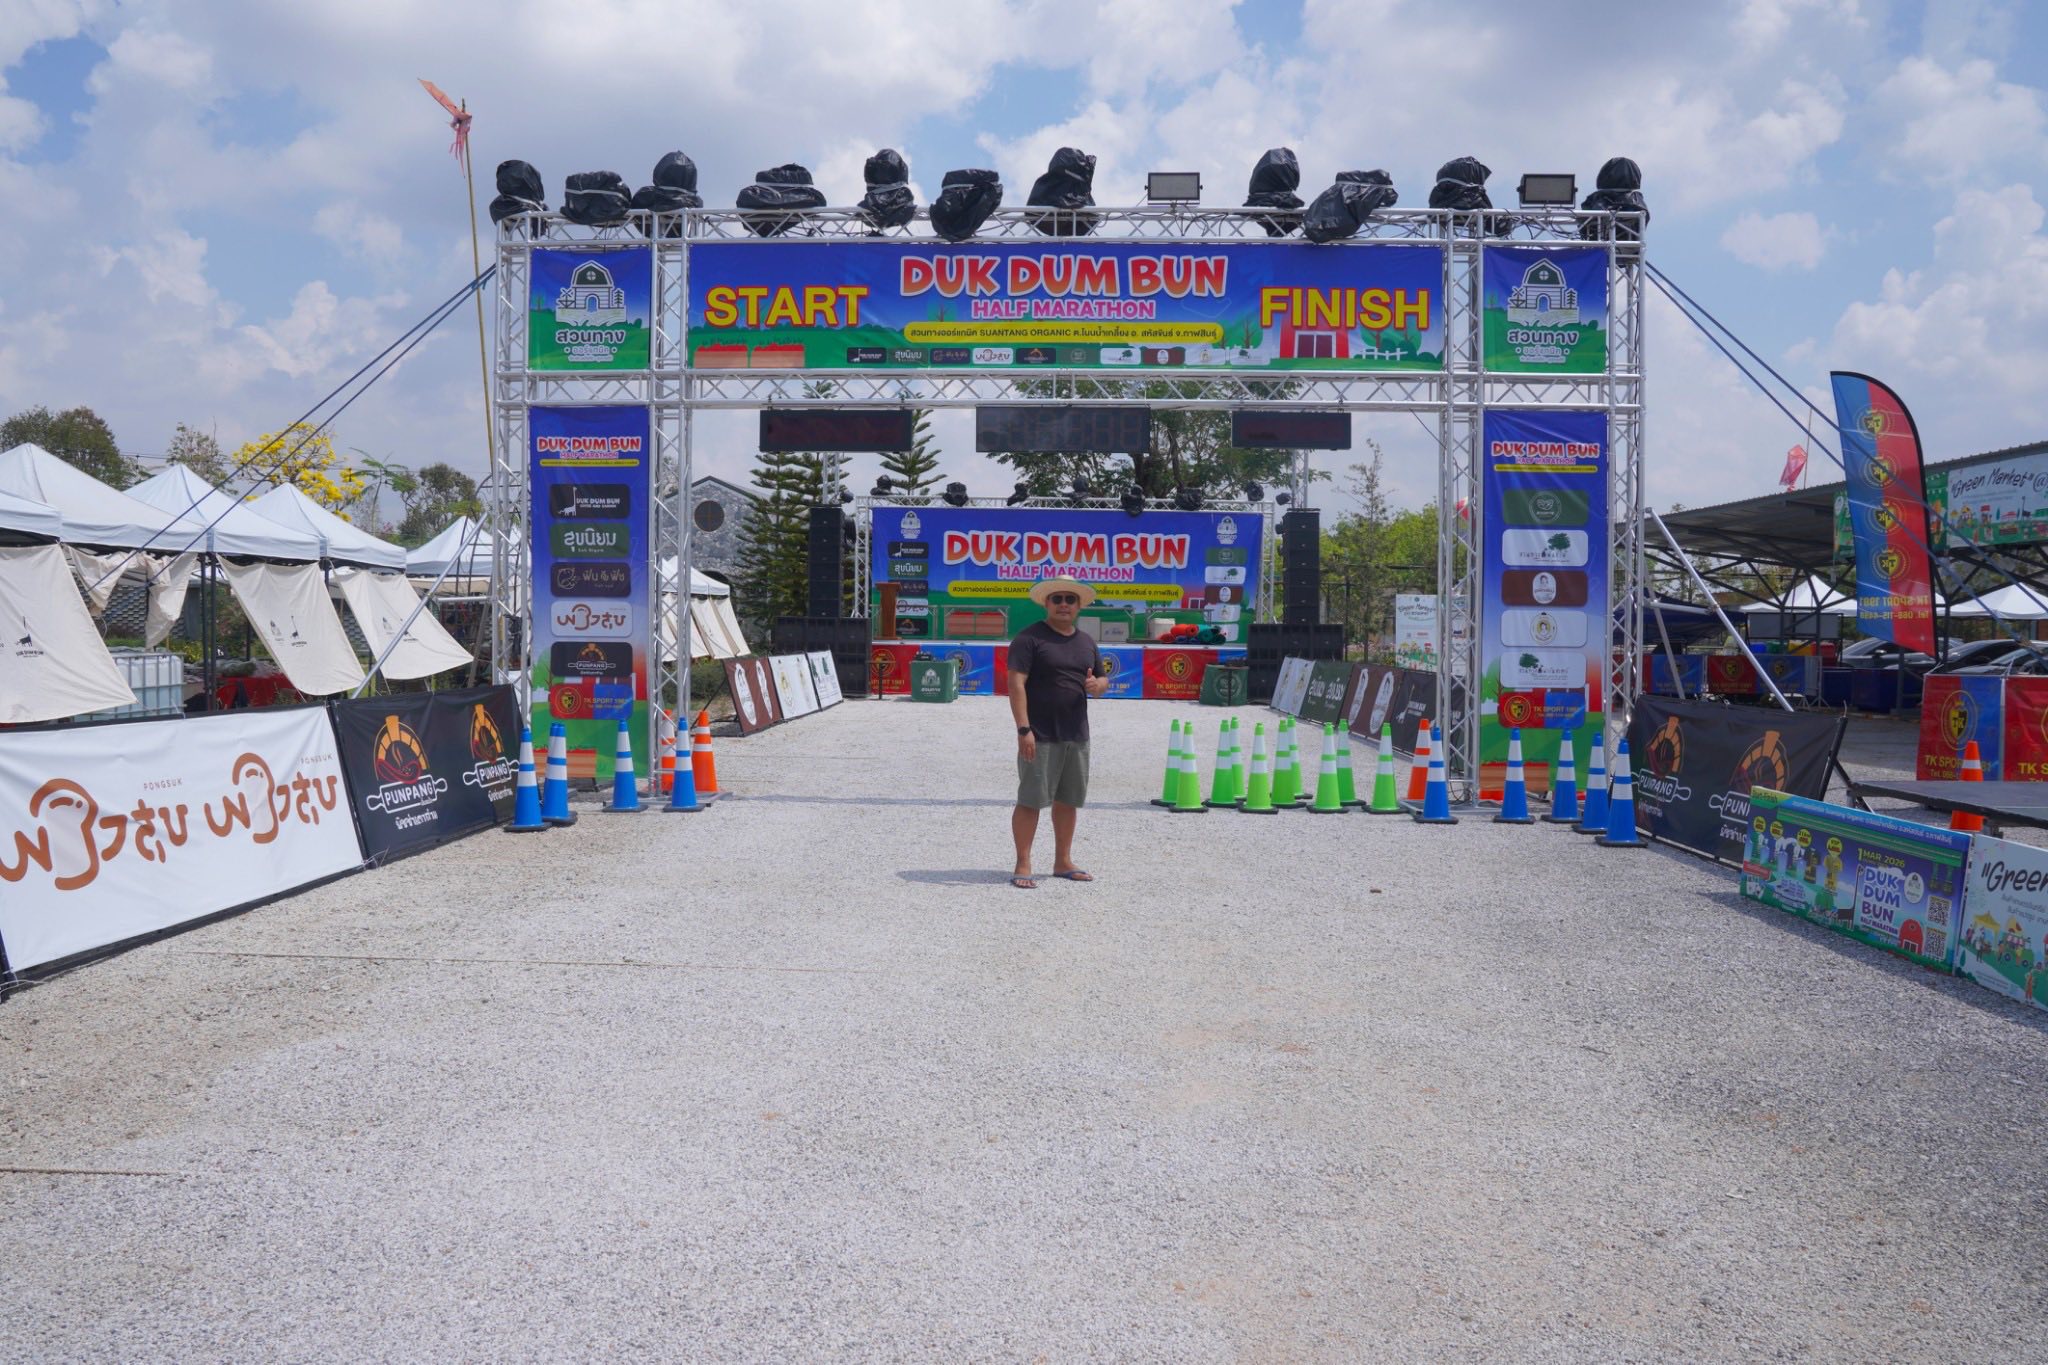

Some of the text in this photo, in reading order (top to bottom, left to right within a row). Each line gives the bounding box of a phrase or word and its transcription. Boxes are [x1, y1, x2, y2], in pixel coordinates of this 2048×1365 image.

[901, 255, 1228, 298] DUK DUM BUN
[705, 285, 869, 328] START
[972, 299, 1155, 320] HALF MARATHON
[1260, 286, 1430, 331] FINISH
[555, 329, 626, 344] สวนทาง
[980, 329, 1027, 337] SUANTANG
[1032, 329, 1071, 337] ORGANIC
[1507, 329, 1579, 345] สวนทาง
[537, 436, 642, 452] DUK DUM BUN
[1491, 441, 1600, 458] DUK DUM BUN
[564, 528, 616, 553] สุขนิยม
[944, 531, 1190, 568] DUK DUM BUN
[998, 564, 1134, 581] HALF MARATHON
[479, 762, 509, 782] PUNPANG
[1940, 757, 1962, 768] SPOR
[2018, 762, 2037, 774] TK
[143, 777, 183, 791] PONGSUK
[384, 780, 434, 806] PUNPANG
[1863, 849, 1882, 861] MAR
[1885, 855, 1905, 868] 2026
[1865, 867, 1898, 889] DUK
[1863, 885, 1900, 908] DUM
[1862, 901, 1894, 924] BUN
